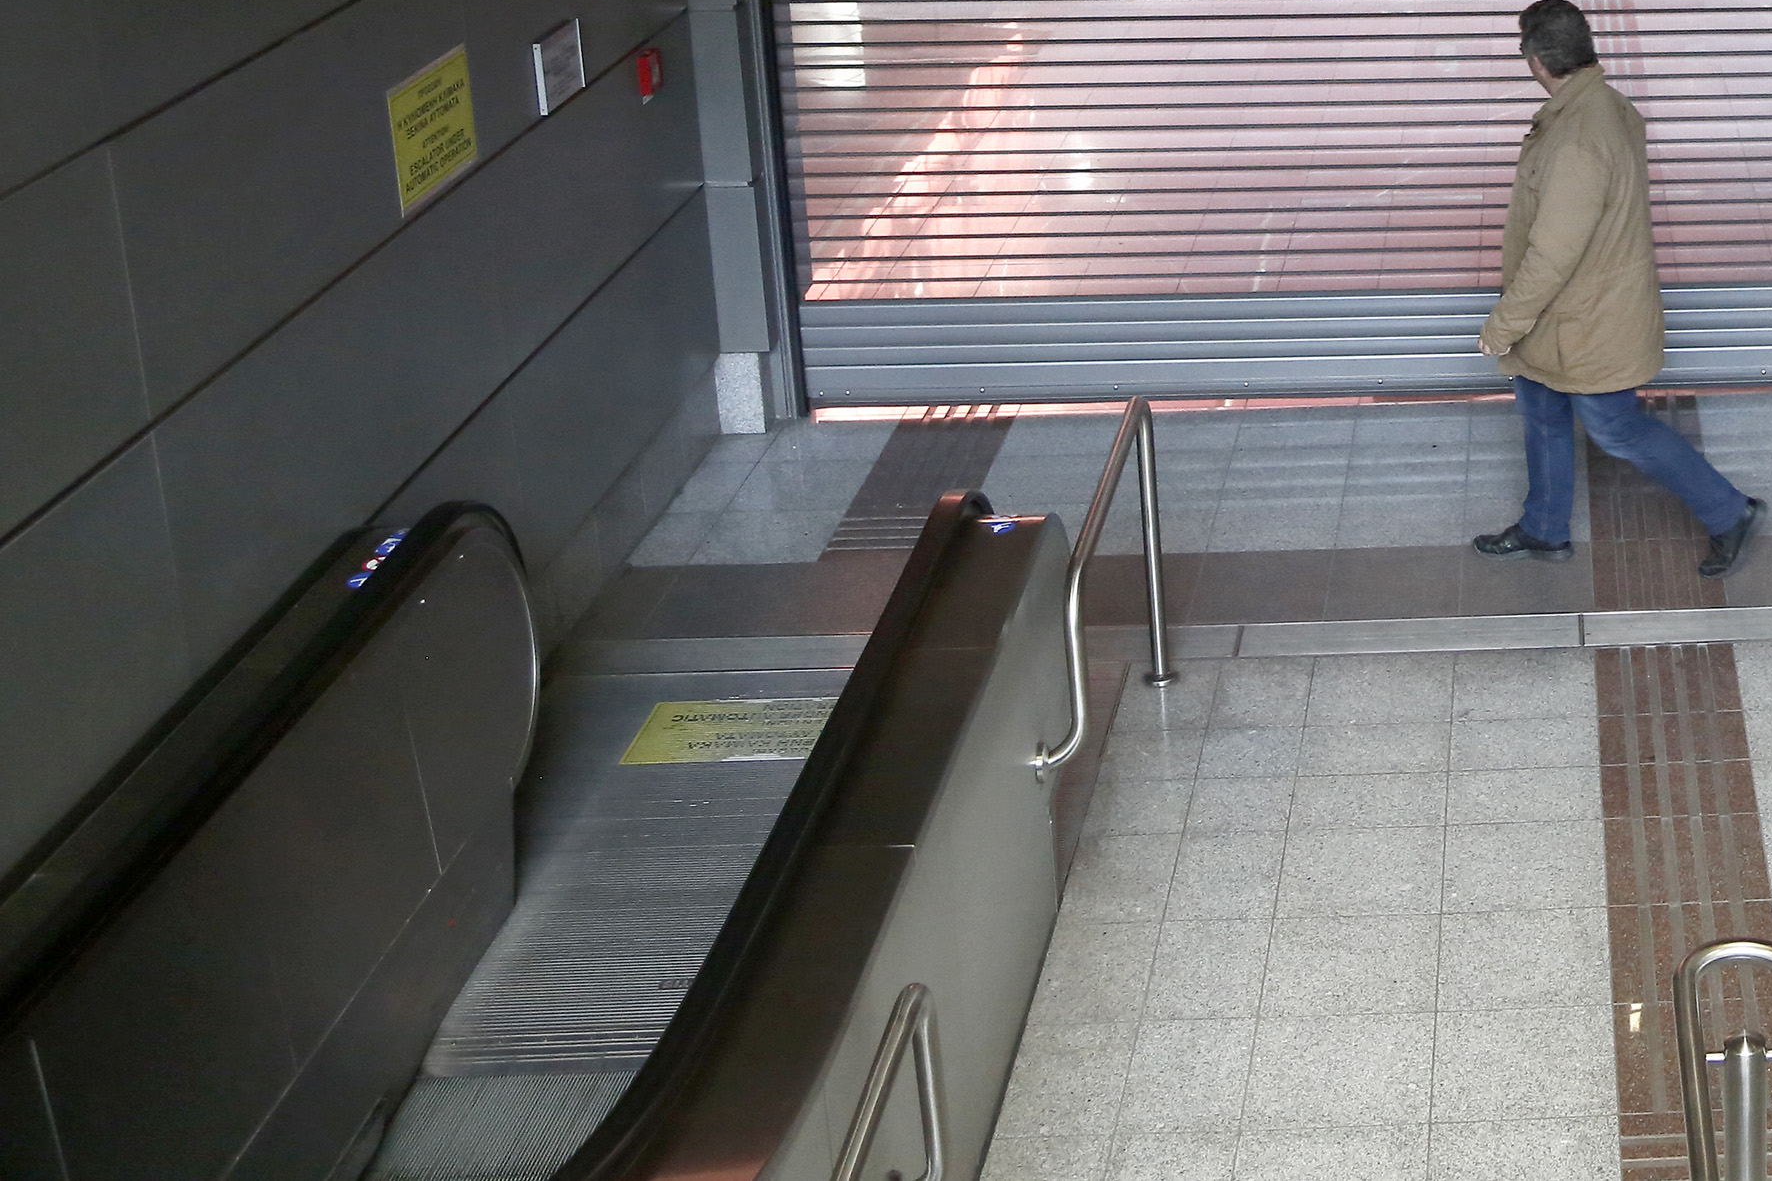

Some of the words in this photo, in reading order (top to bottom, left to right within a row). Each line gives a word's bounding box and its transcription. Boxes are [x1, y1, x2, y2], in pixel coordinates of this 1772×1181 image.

[405, 160, 440, 194] AUTOMATIC
[439, 137, 472, 168] OPERATION
[409, 141, 446, 177] ESCALATOR
